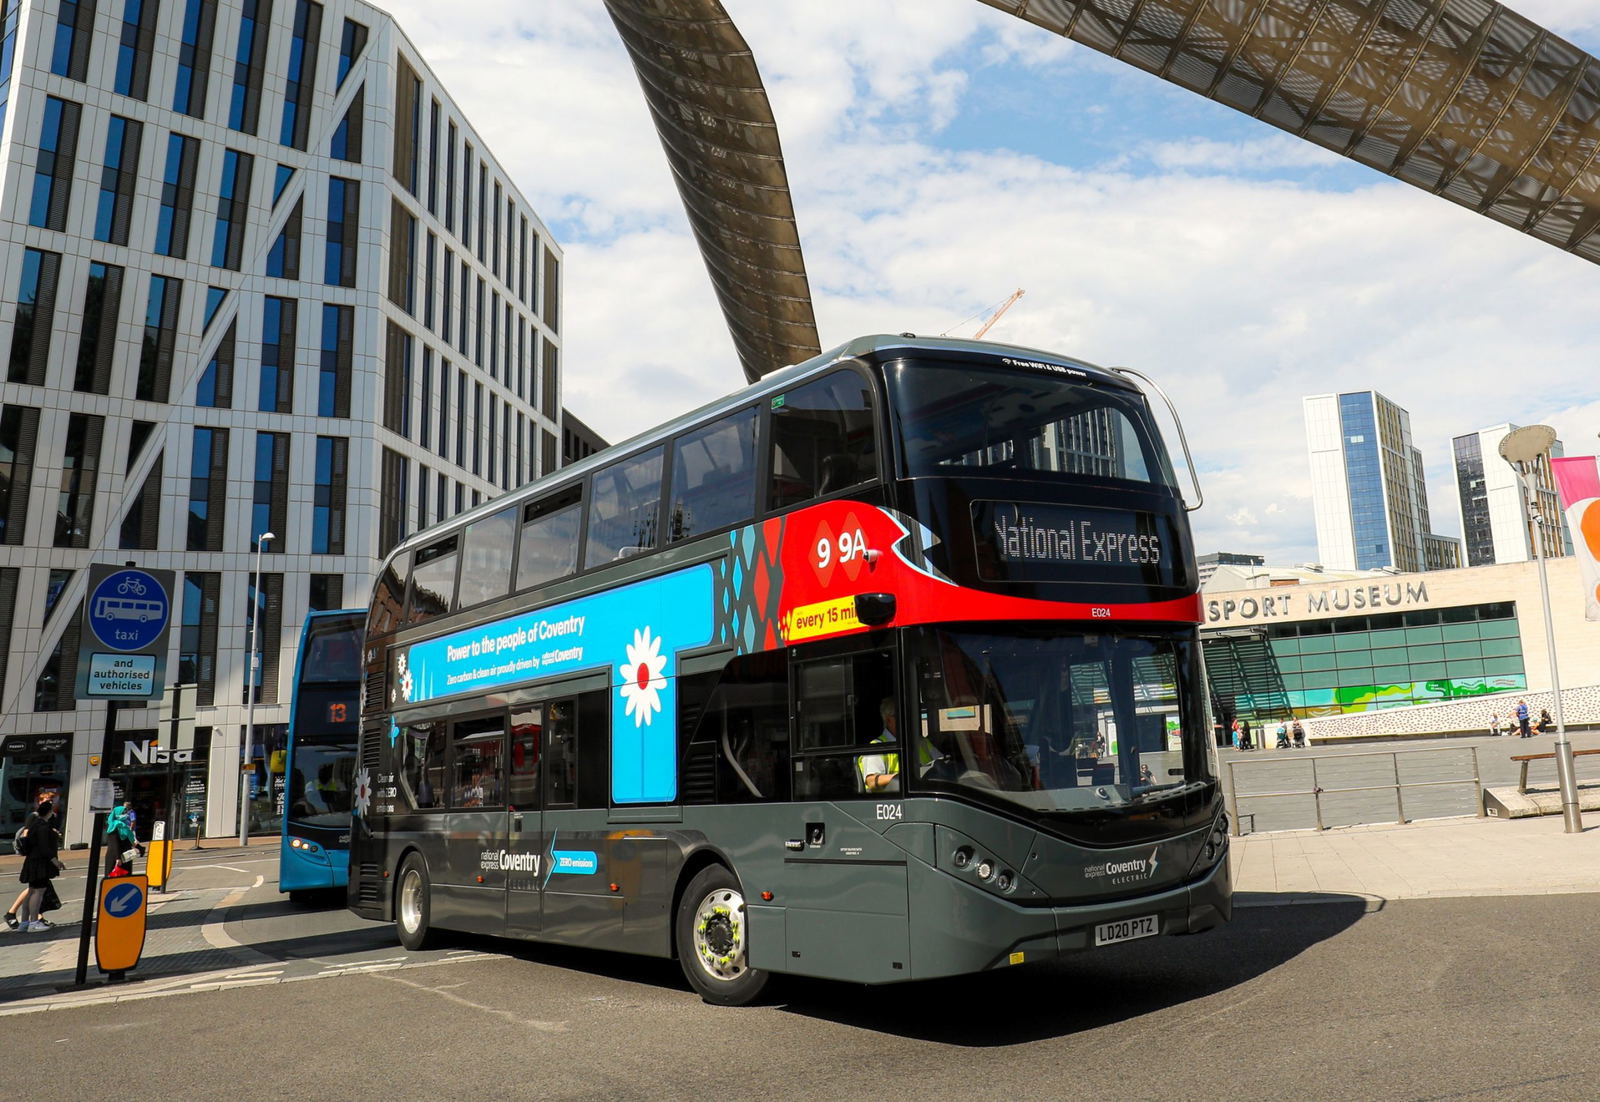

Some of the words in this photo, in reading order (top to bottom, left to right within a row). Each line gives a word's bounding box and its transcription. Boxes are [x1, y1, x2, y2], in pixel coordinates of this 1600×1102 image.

[995, 515, 1076, 560] National
[1081, 521, 1159, 564] Express
[817, 538, 831, 569] 9
[838, 528, 866, 563] 9A
[1308, 581, 1429, 613] MUSEUM
[796, 612, 825, 630] every
[827, 607, 838, 623] 15
[1091, 608, 1111, 618] E024
[115, 629, 139, 640] taxi
[447, 645, 471, 663] Power
[471, 640, 480, 657] to
[481, 635, 496, 655] the
[496, 626, 526, 656] people
[528, 622, 538, 642] of
[539, 615, 586, 637] Coventry
[554, 646, 584, 662] Coventry
[114, 659, 134, 668] and
[94, 669, 150, 679] authorised
[100, 681, 143, 690] vehicles
[329, 703, 347, 723] 13
[123, 740, 193, 766] Nisa
[876, 804, 903, 820] E024
[481, 849, 499, 860] national
[480, 861, 500, 872] express
[499, 849, 541, 877] Coventry
[1084, 864, 1105, 872] national
[1106, 860, 1146, 874] Coventry
[1112, 873, 1147, 884] ELECTRIC
[1100, 923, 1128, 941] LD20
[1132, 918, 1152, 935] PTZ
